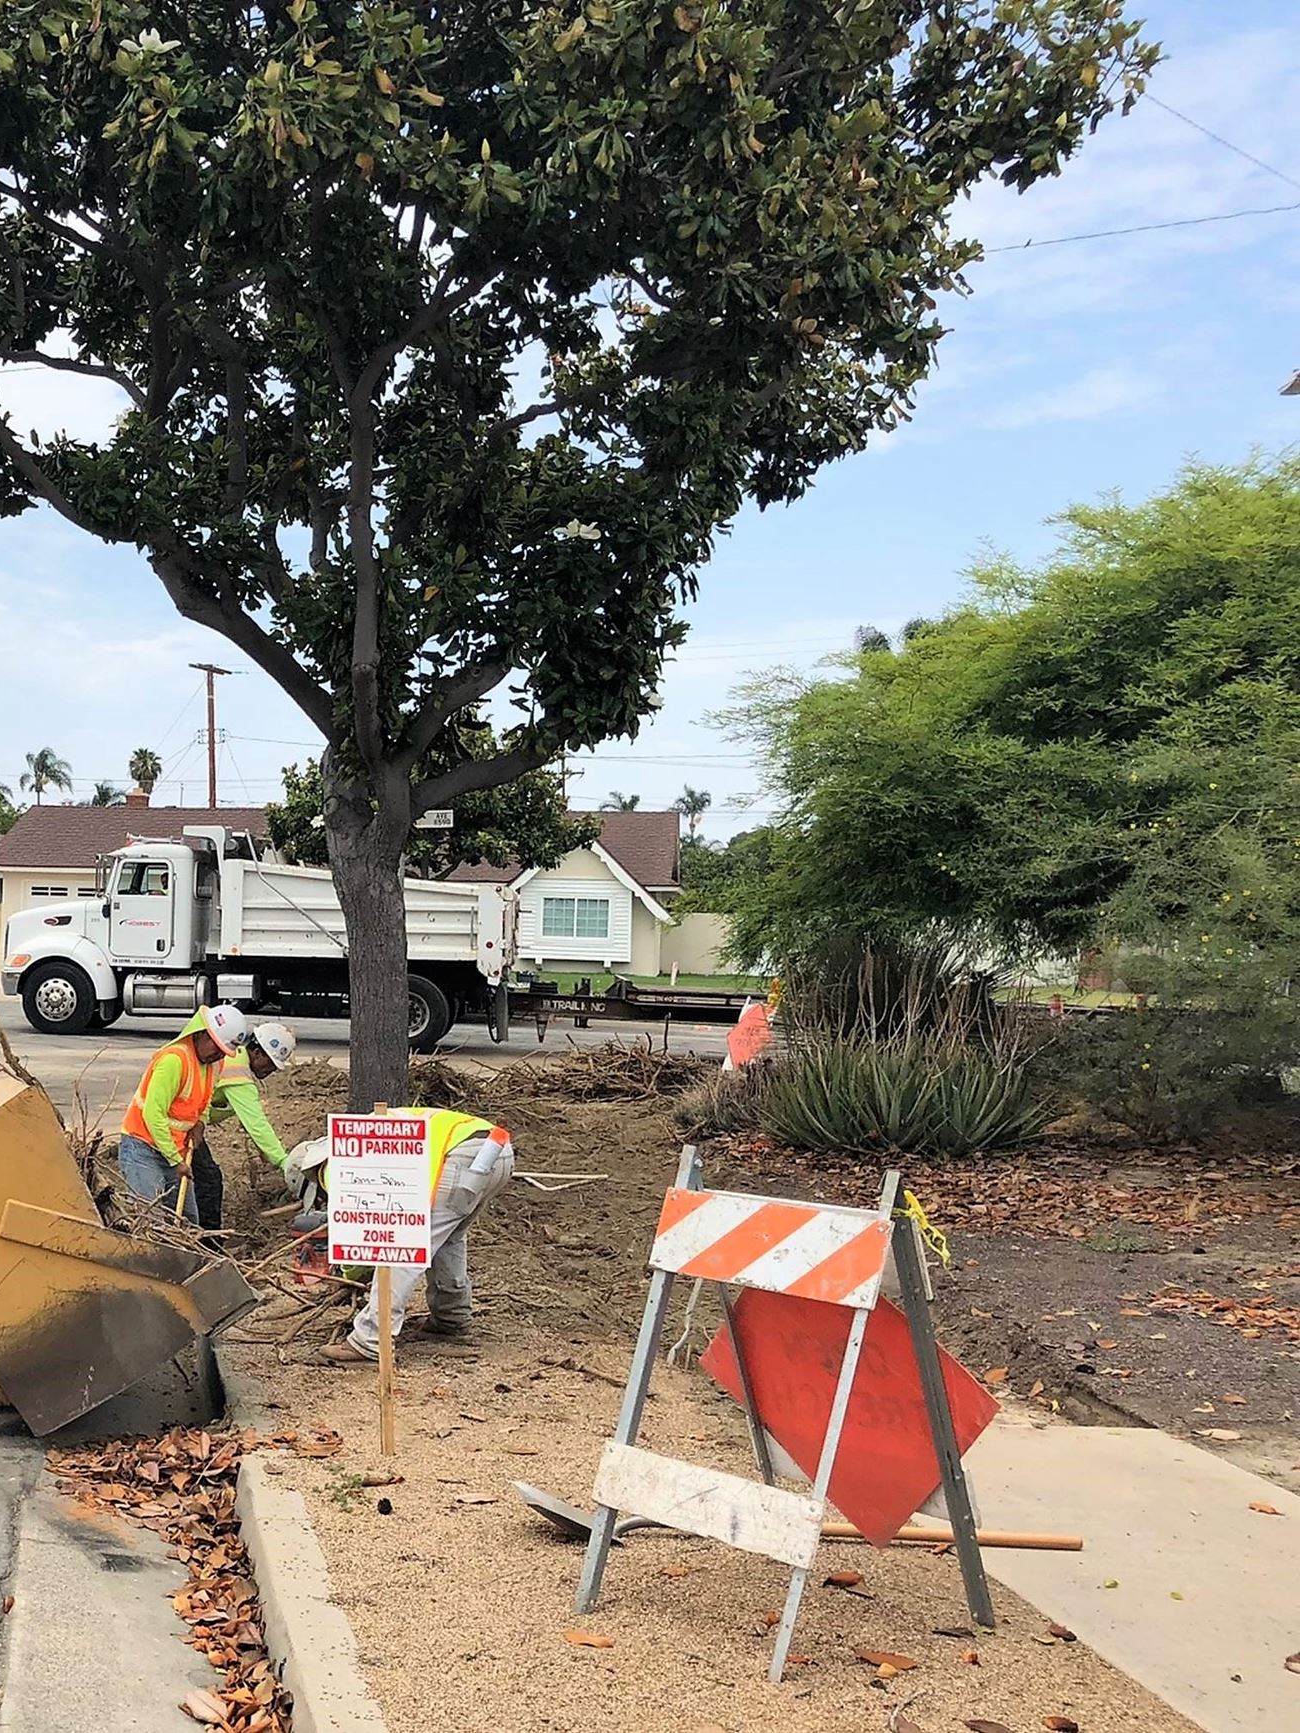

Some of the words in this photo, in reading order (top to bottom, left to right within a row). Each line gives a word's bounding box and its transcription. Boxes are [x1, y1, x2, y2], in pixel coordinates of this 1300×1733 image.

[552, 1000, 580, 1011] TRAIL
[337, 1120, 420, 1137] TEMPORARY
[334, 1137, 360, 1157] NO
[365, 1140, 424, 1156] PARKING
[333, 1210, 426, 1226] CONSTRUCTION
[363, 1229, 395, 1243] ZONE
[341, 1246, 418, 1262] TOW-AWAY
